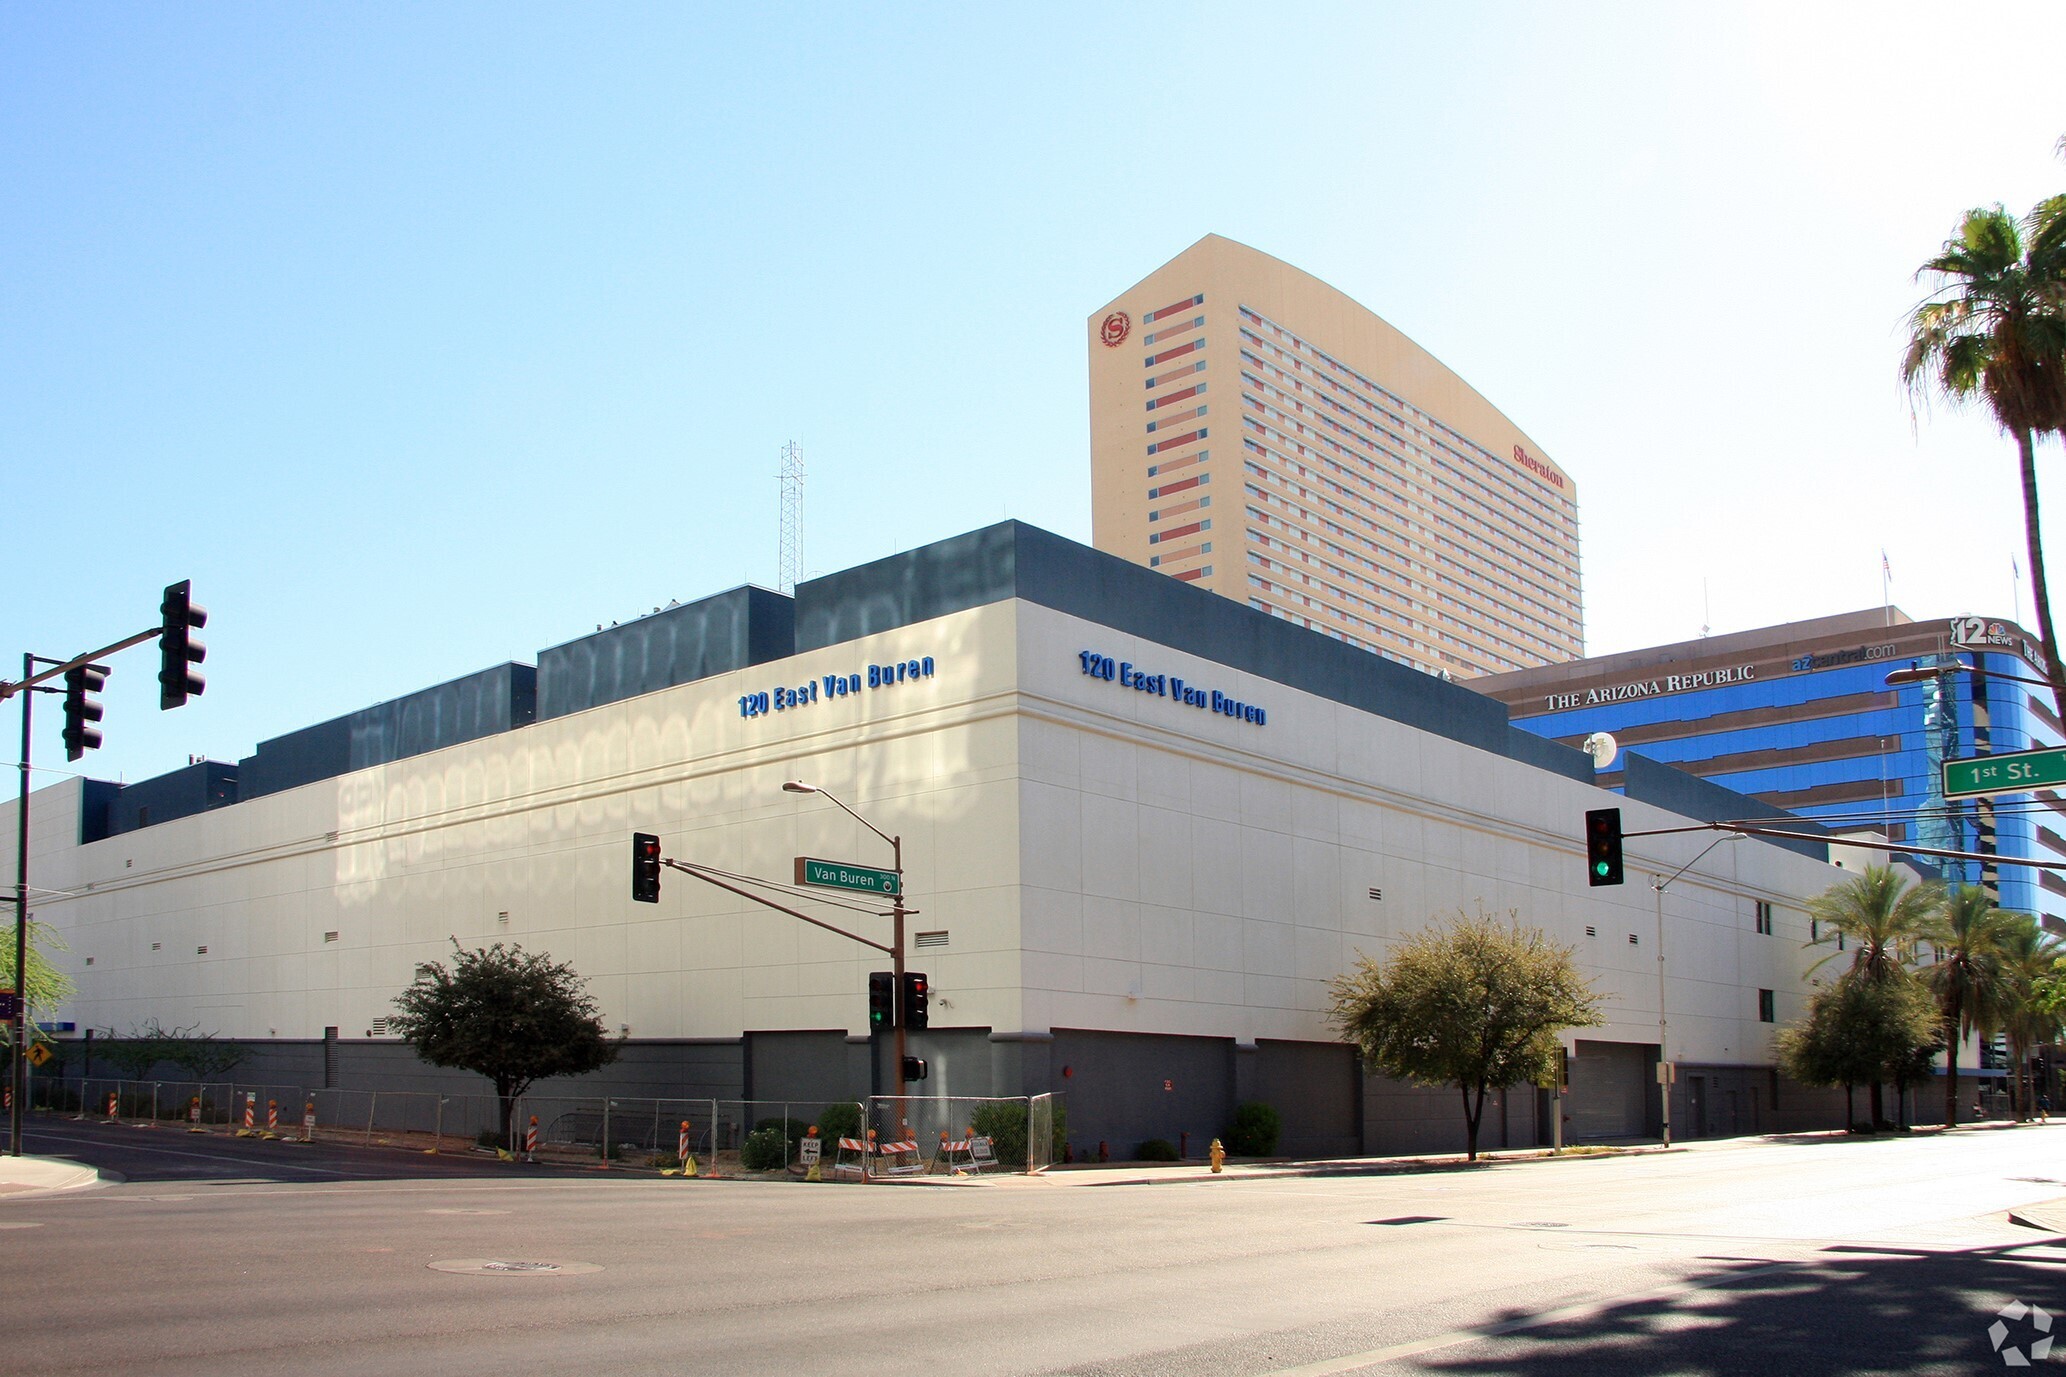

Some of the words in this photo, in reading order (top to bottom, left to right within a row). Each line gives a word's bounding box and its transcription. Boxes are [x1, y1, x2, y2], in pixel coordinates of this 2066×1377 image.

[1513, 444, 1564, 489] Sheraton
[1956, 617, 1987, 644] 12
[1988, 635, 2013, 647] NEWS
[1791, 644, 1896, 672] azcentral.com
[738, 691, 769, 717] 120
[773, 680, 818, 710] East
[822, 673, 862, 699] Van
[867, 656, 935, 689] Buren
[1078, 650, 1115, 682] 120
[1120, 661, 1167, 697] East
[1170, 677, 1208, 708] Van
[1212, 689, 1267, 726] Buren
[1545, 694, 1581, 710] THE
[1585, 680, 1661, 705] ARIZONA
[1666, 665, 1755, 692] REPUBLIC
[1970, 765, 1998, 784] 1st
[2006, 762, 2040, 780] St.
[814, 866, 836, 881] Van
[840, 870, 875, 887] Buren
